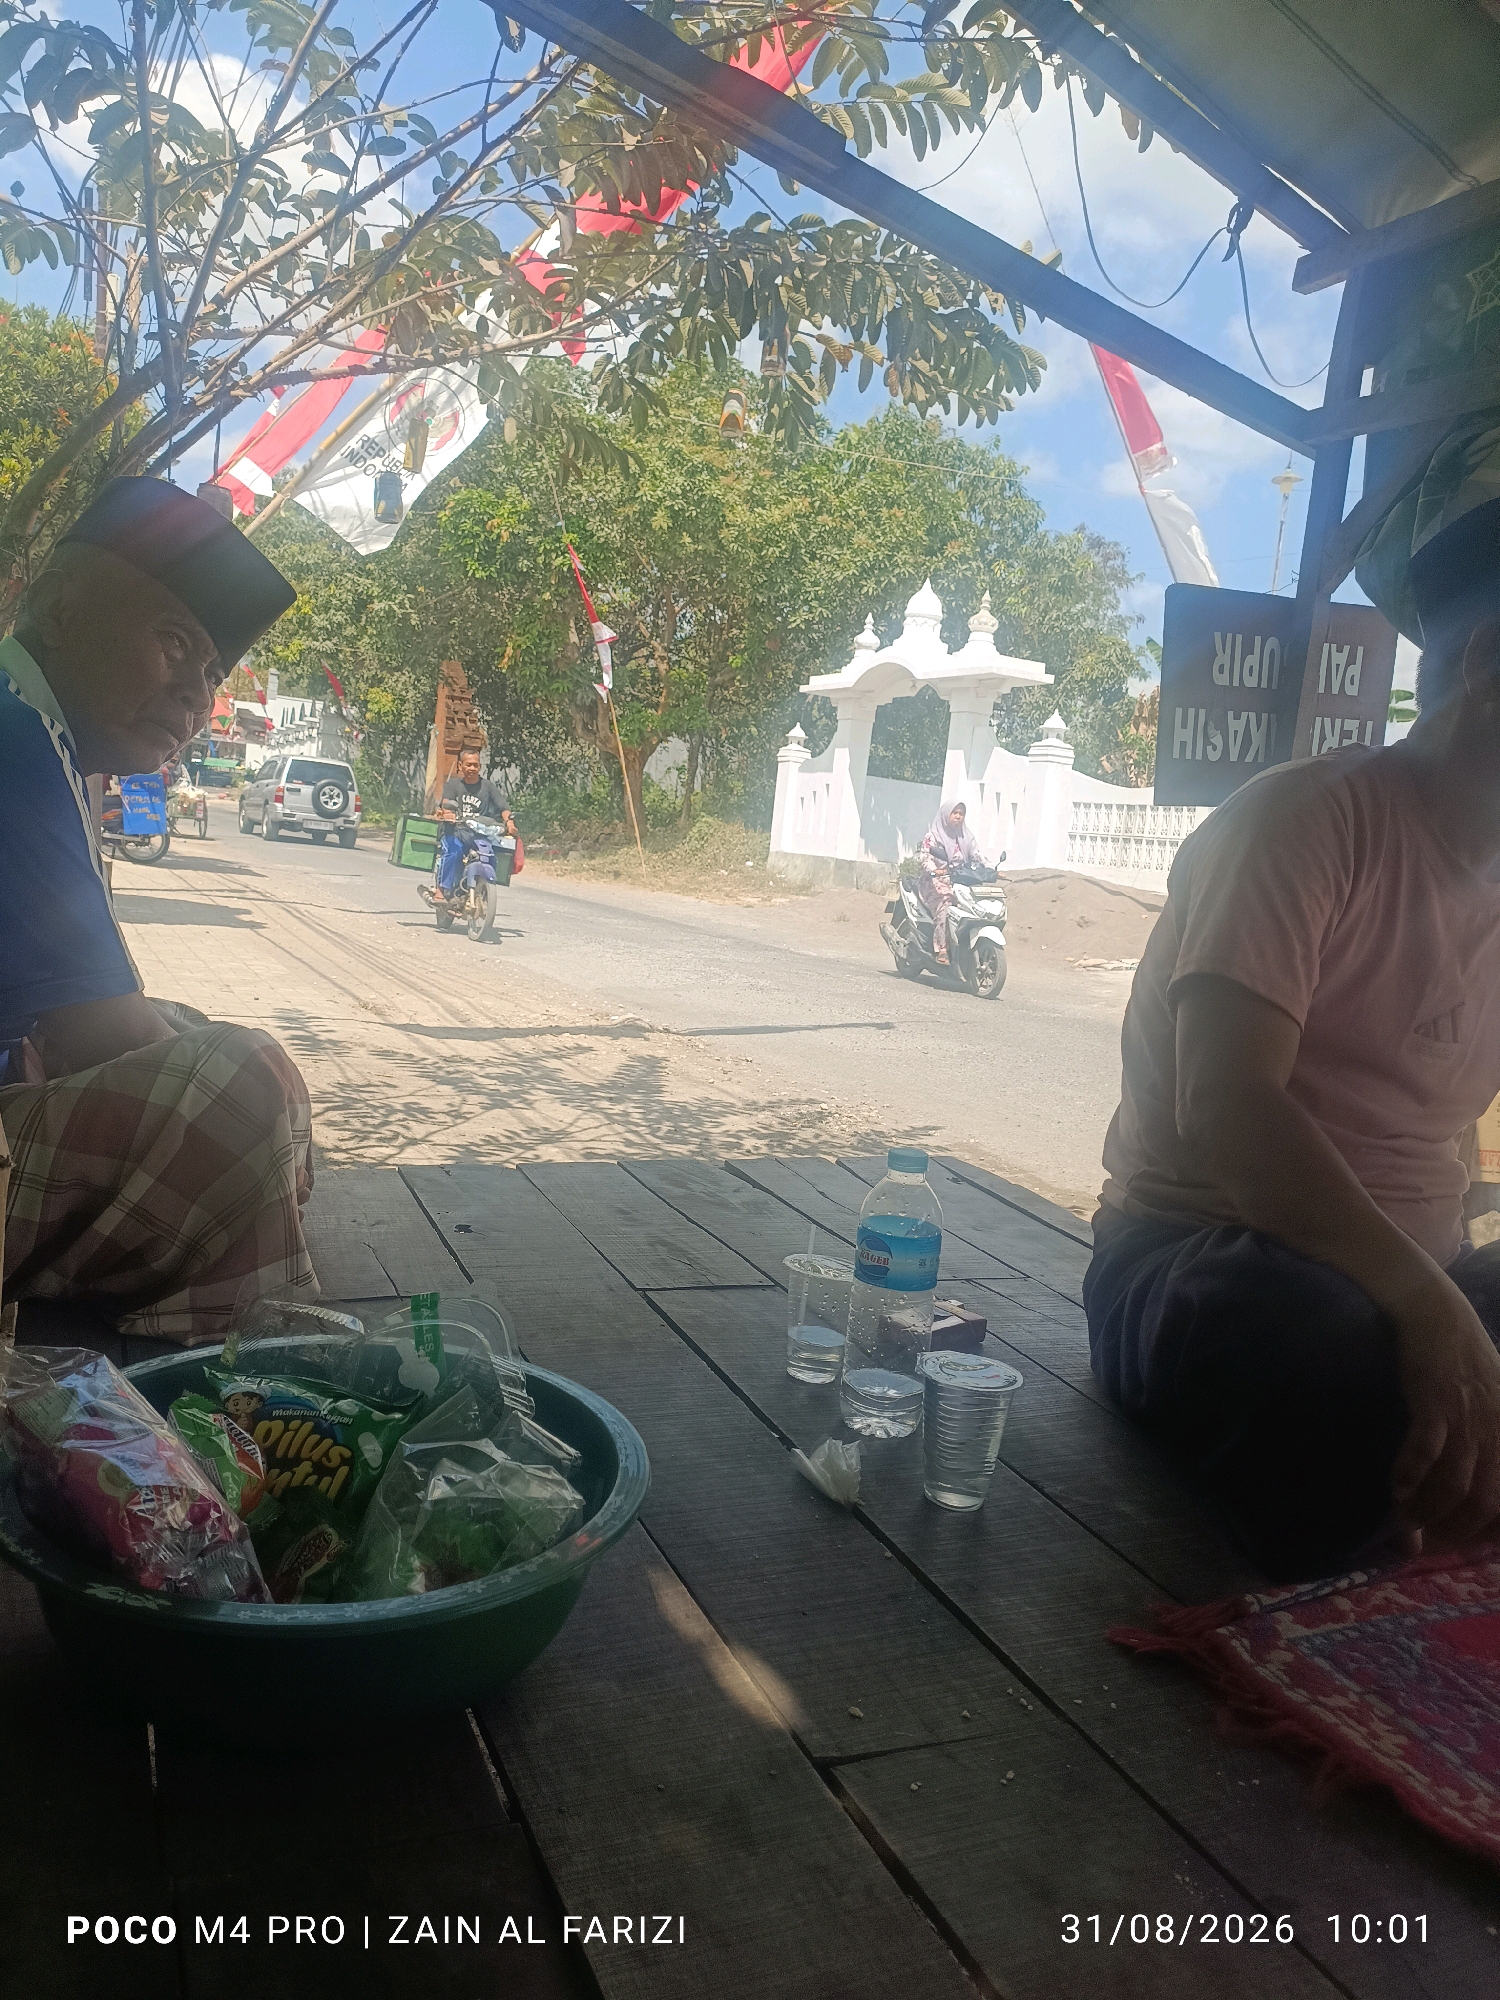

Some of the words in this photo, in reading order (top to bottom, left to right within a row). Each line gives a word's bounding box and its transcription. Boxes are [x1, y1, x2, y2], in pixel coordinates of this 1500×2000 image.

[1212, 631, 1289, 690] UPIR
[1172, 707, 1267, 763] KASIH
[252, 1418, 353, 1470] Pilus
